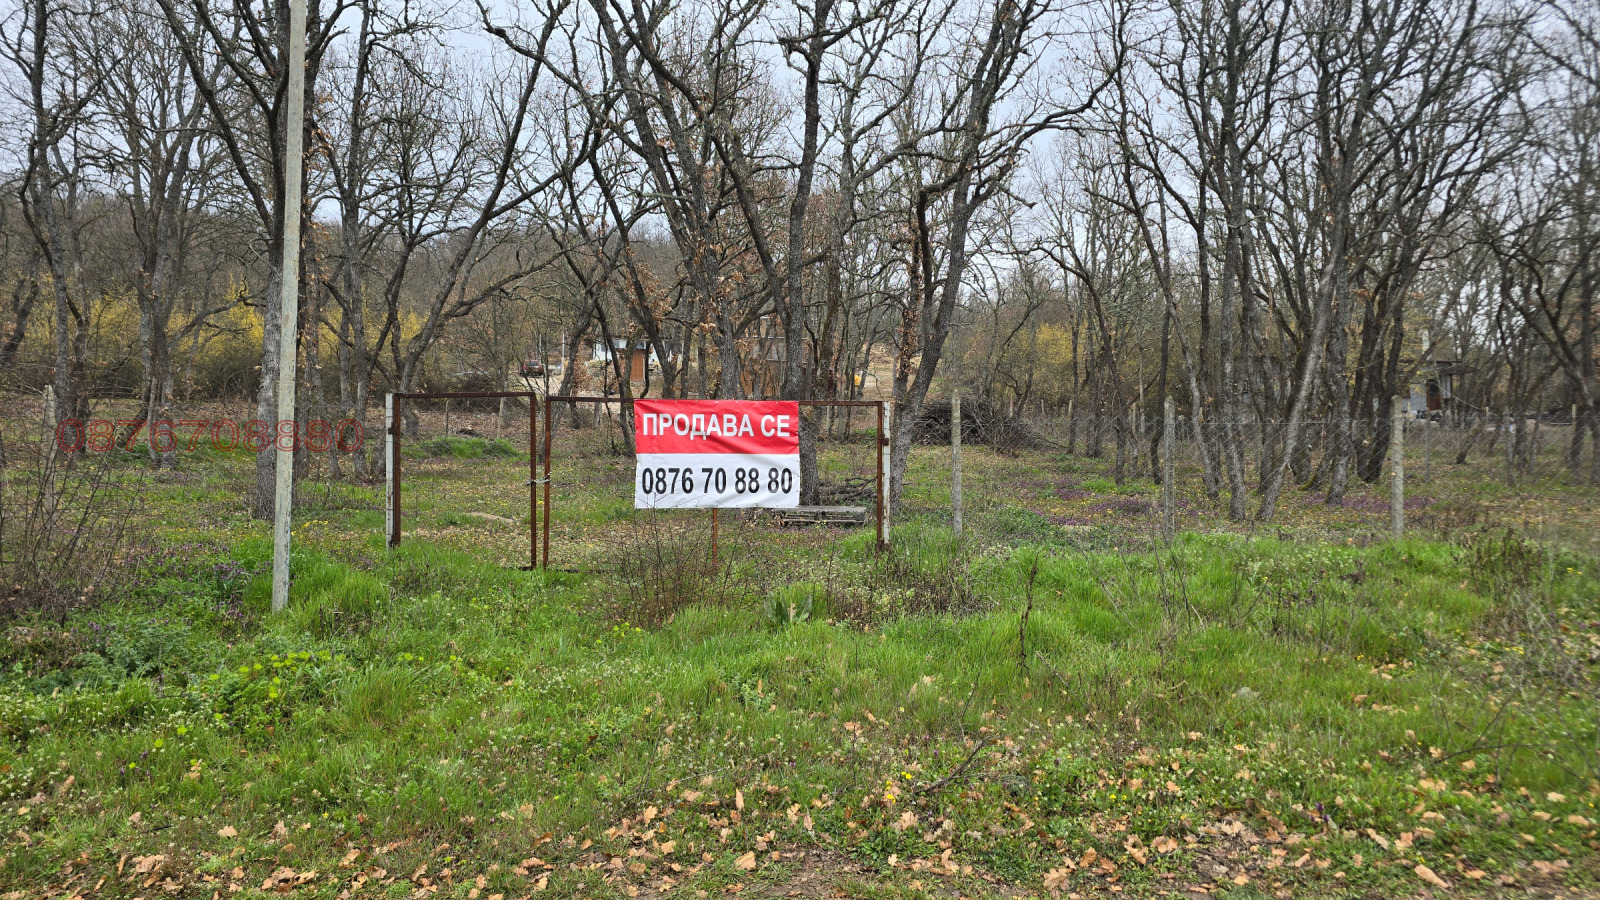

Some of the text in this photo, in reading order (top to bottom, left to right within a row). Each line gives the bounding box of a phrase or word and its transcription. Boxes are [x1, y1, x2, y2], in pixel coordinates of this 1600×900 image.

[643, 413, 790, 440] ПРОДАВА СЕ
[642, 467, 793, 495] 0876 70 88 80
